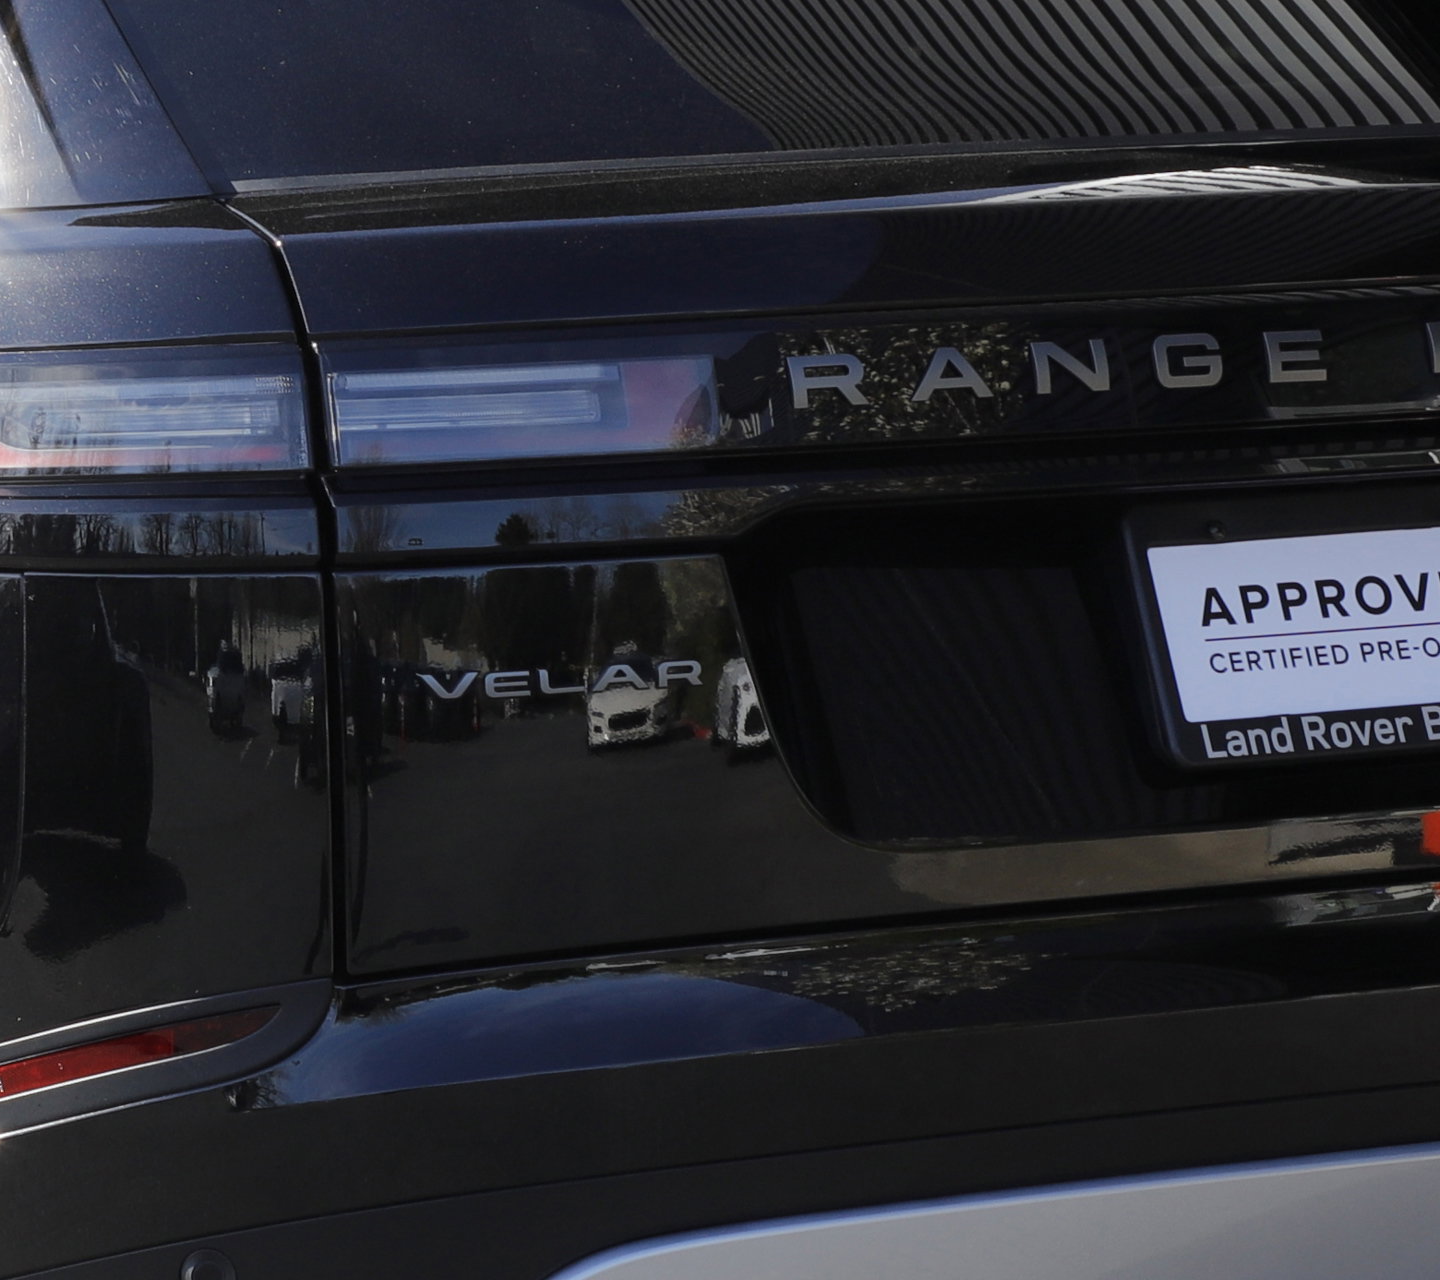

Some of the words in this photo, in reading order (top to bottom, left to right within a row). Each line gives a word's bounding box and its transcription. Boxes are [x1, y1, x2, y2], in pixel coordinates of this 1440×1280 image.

[786, 330, 1328, 409] RANGE
[416, 660, 703, 699] VELAR
[1210, 645, 1349, 673] CERTIFIED
[1201, 717, 1294, 759] Land
[1301, 714, 1413, 750] Rover
